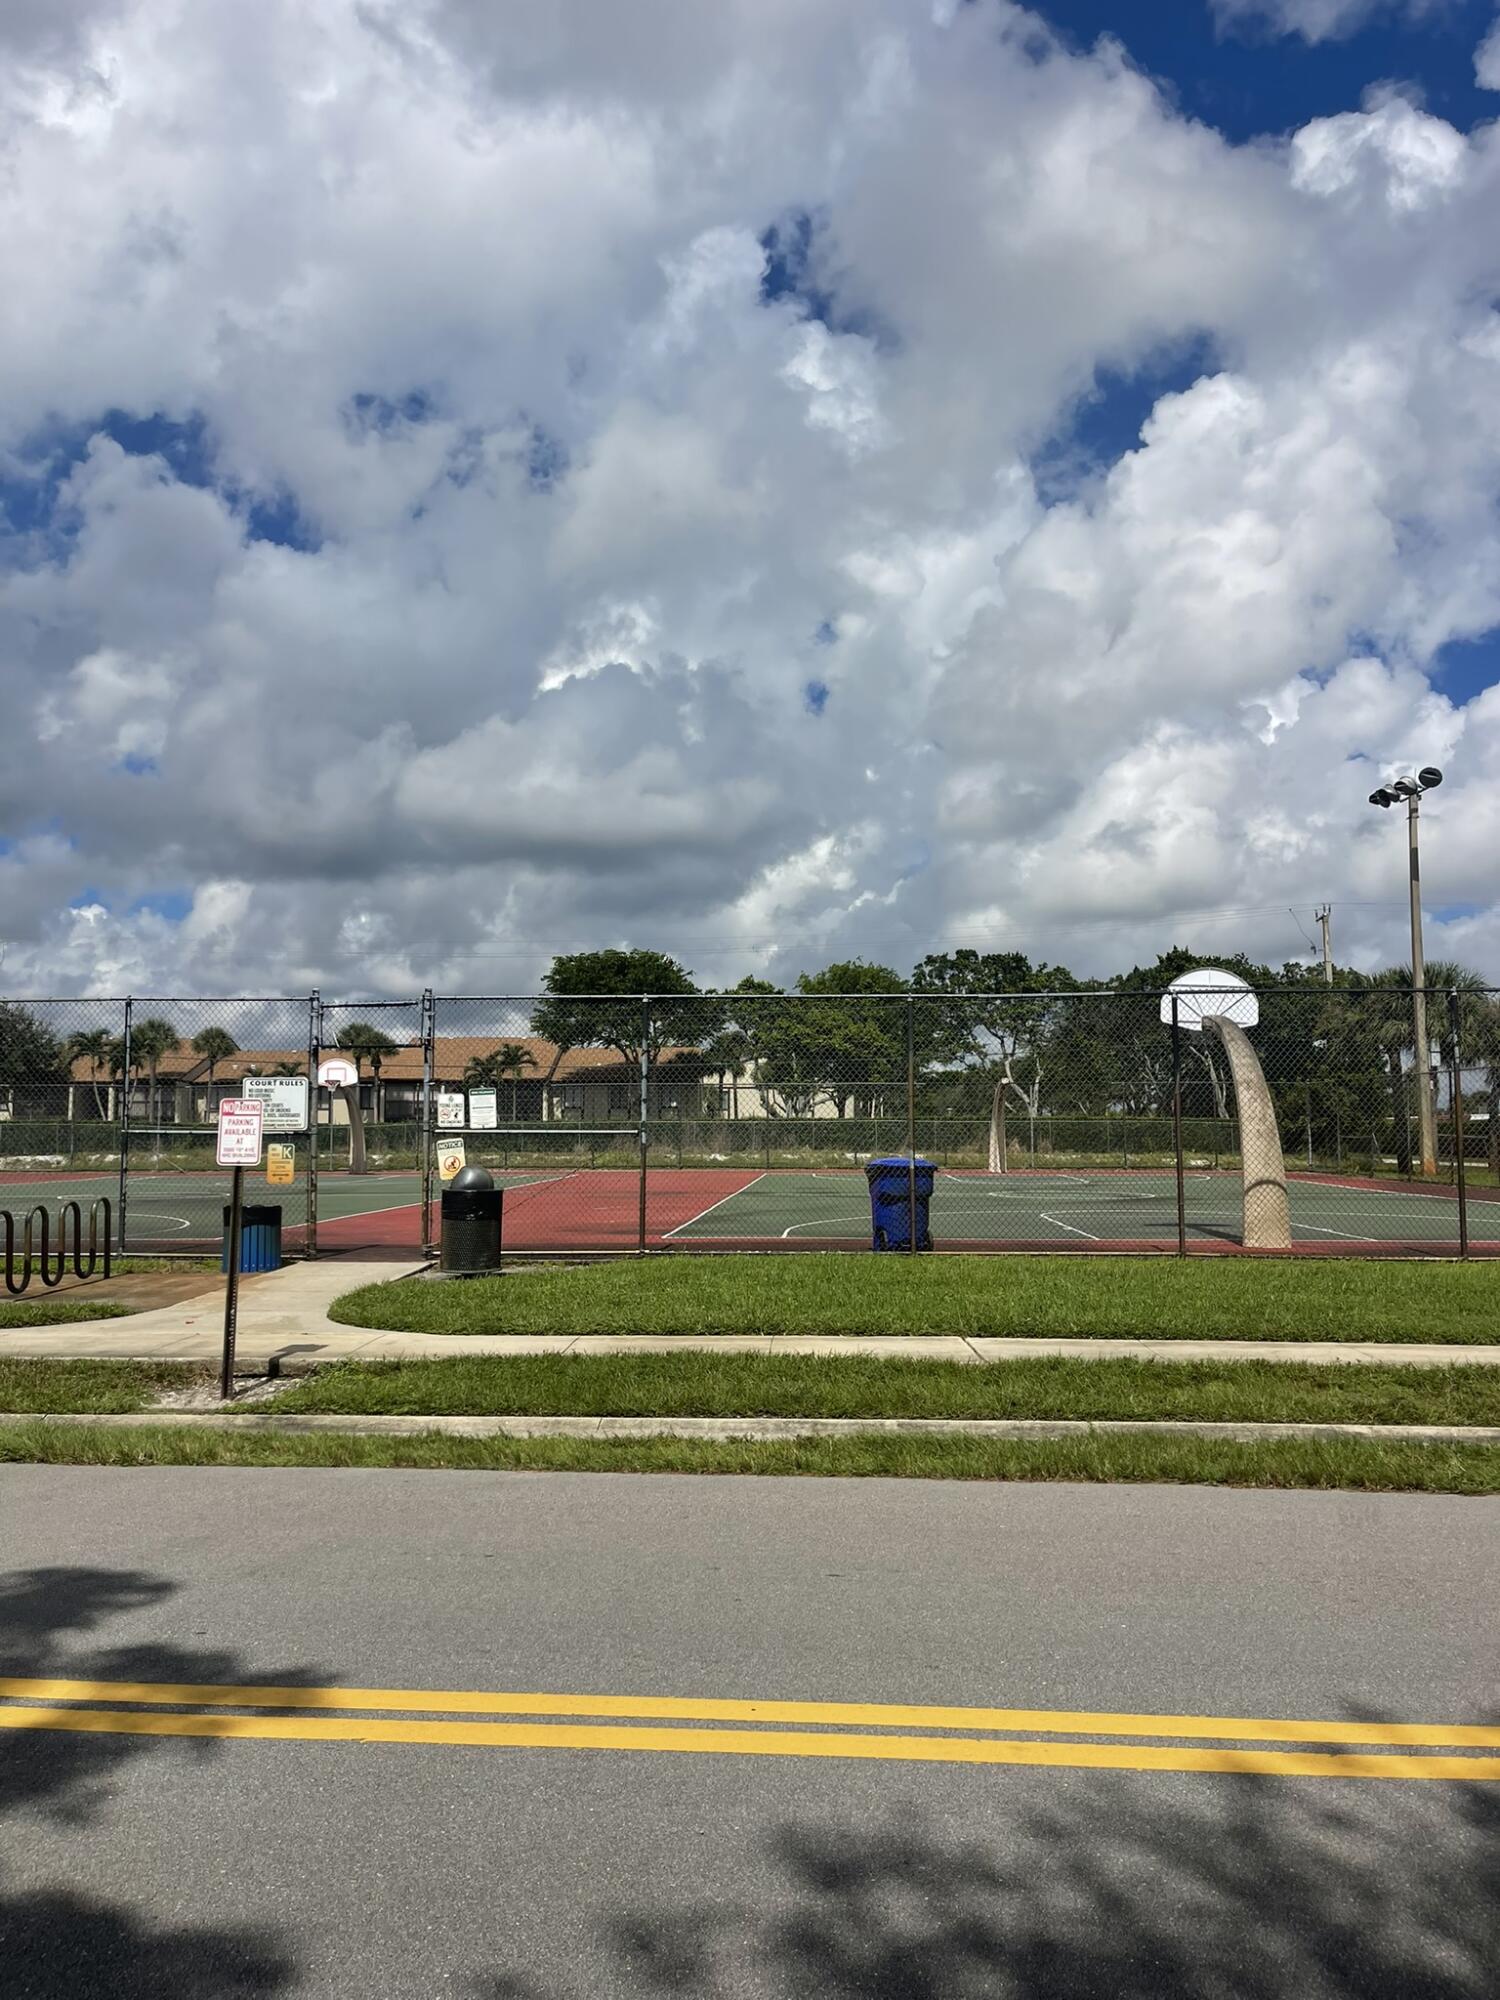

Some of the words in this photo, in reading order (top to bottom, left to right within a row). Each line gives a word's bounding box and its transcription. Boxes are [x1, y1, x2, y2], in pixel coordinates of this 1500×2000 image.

[223, 1102, 234, 1113] NO
[234, 1103, 260, 1112] PARKING
[227, 1118, 254, 1126] PARKING
[224, 1128, 257, 1136] AVAILABLE
[438, 1141, 462, 1149] NOTICE
